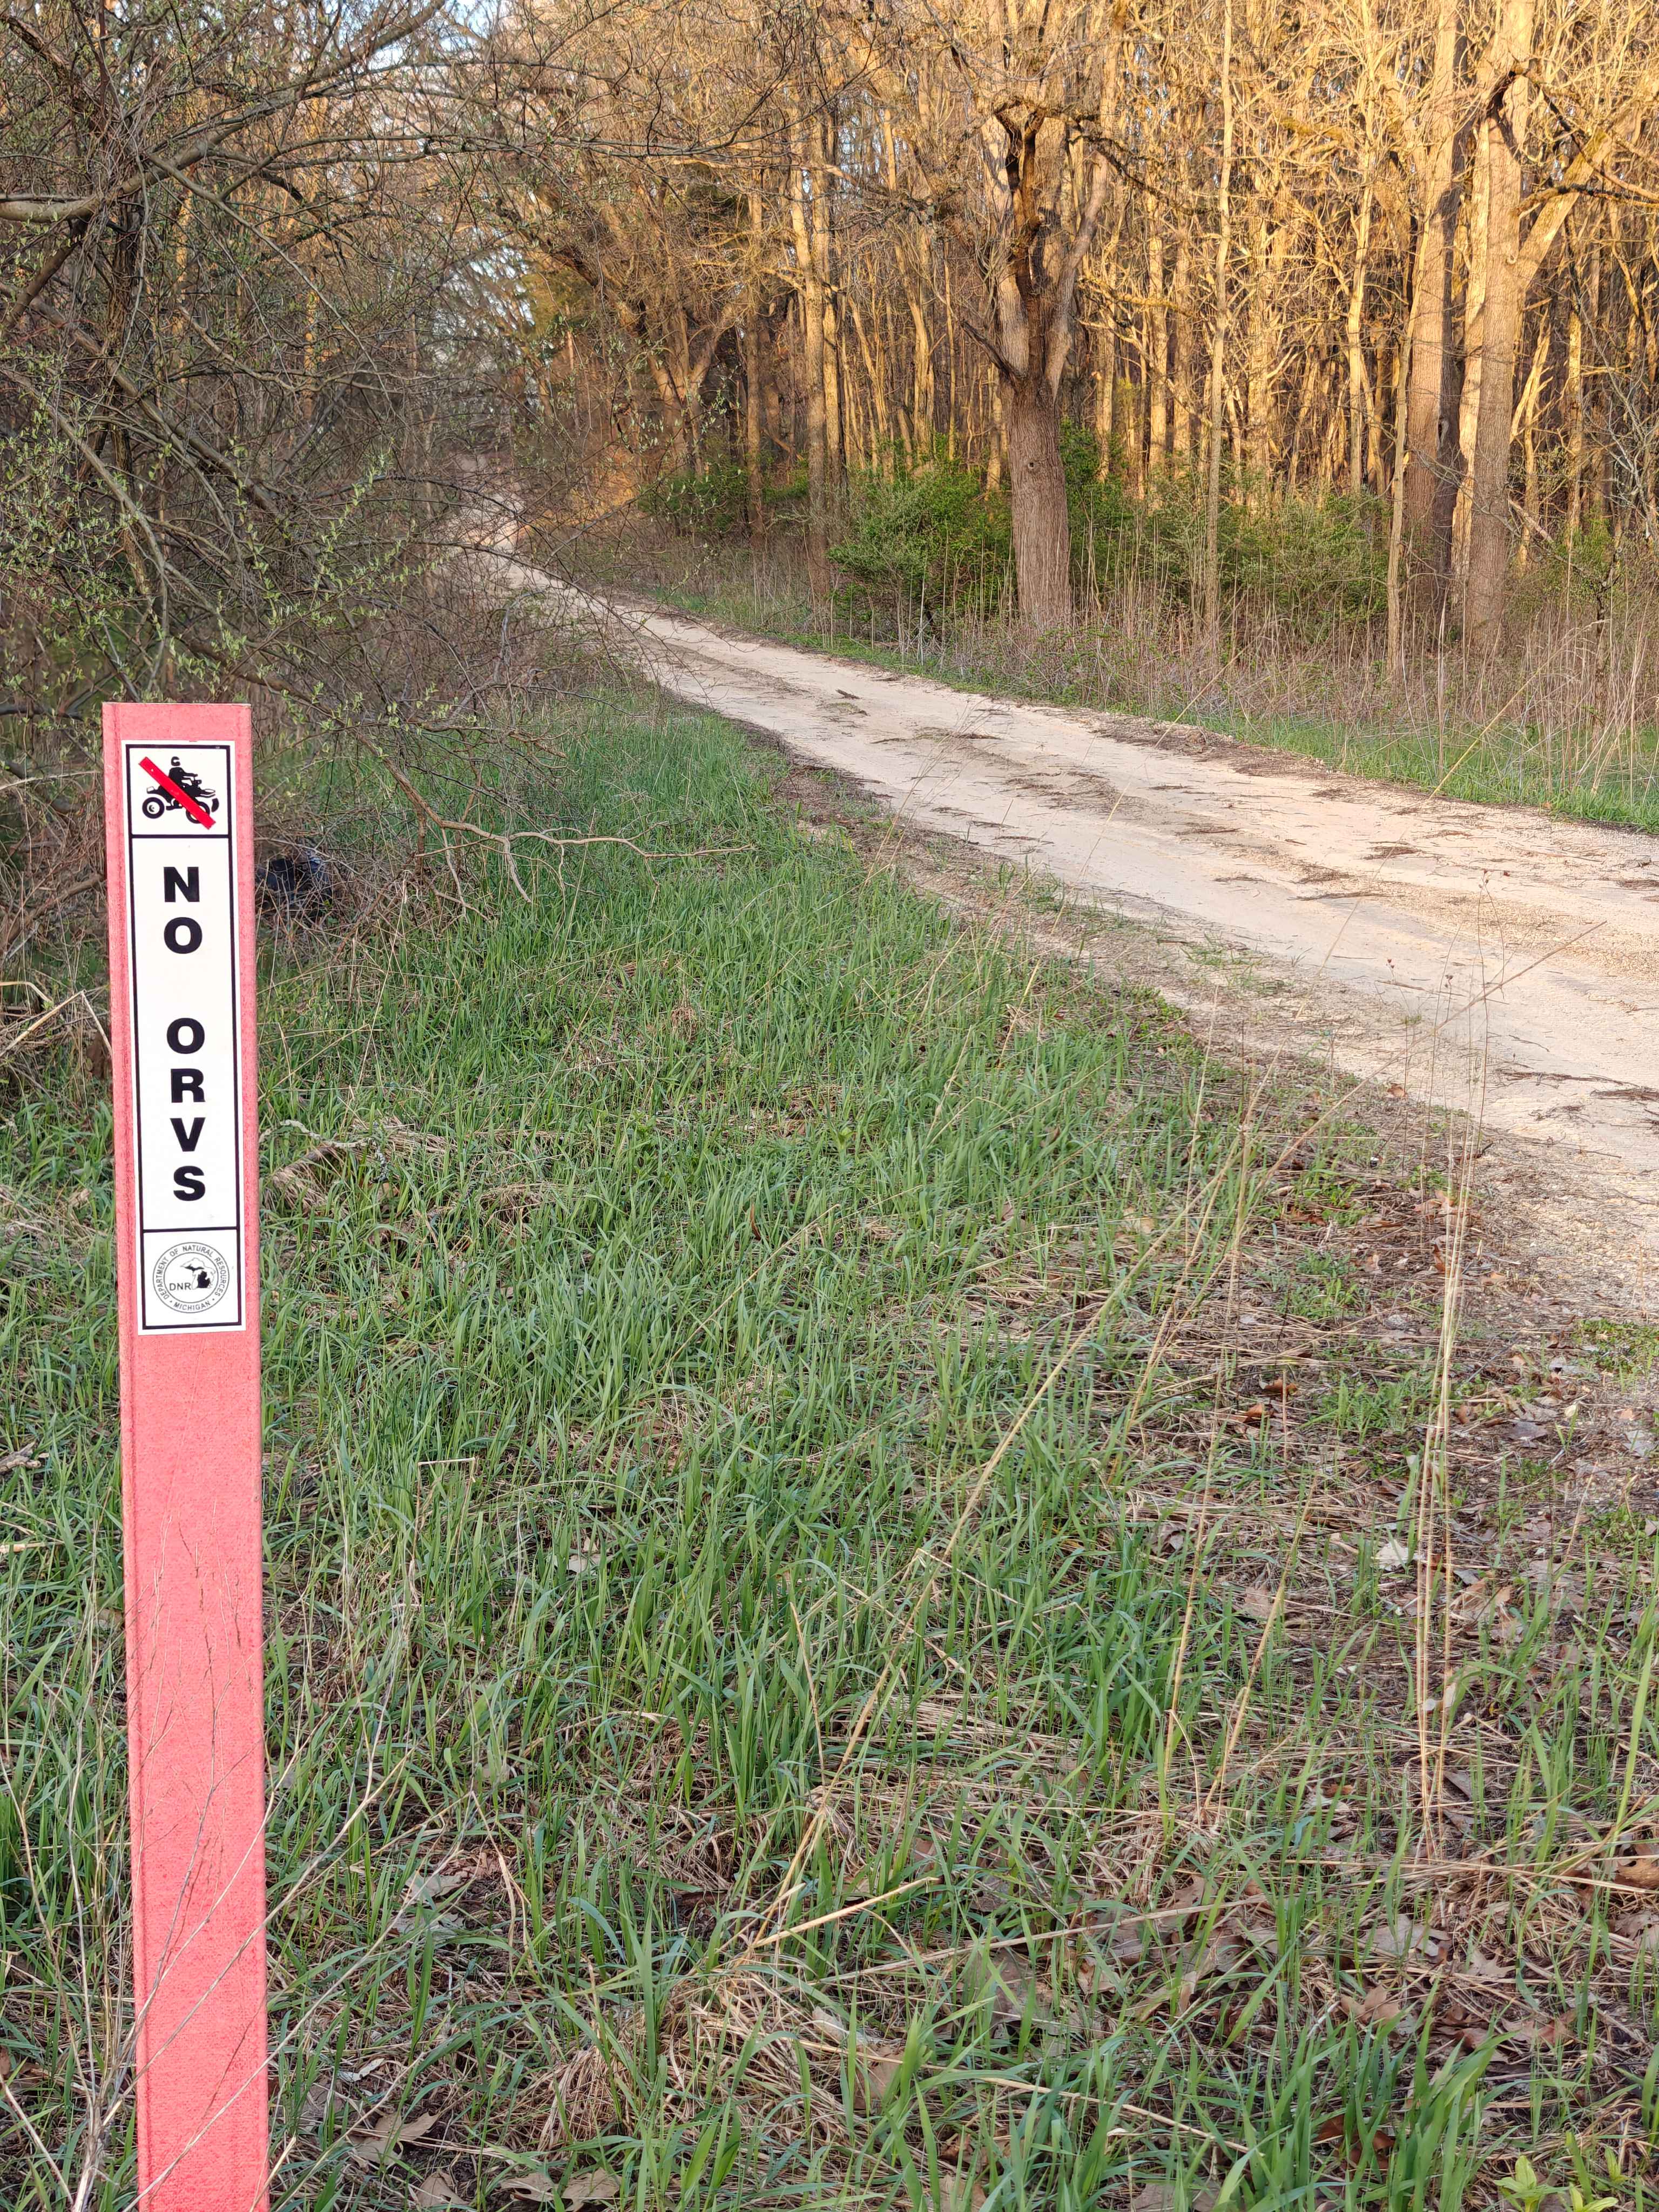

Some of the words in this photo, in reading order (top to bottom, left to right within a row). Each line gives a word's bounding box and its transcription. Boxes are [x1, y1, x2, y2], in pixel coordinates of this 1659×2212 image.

[164, 866, 203, 954] NO
[166, 1017, 206, 1202] ORVS
[156, 1257, 170, 1300] DEPARTMENT
[170, 1249, 179, 1257] OF
[183, 1245, 214, 1257] NATURAL
[214, 1257, 227, 1297] RESOURCES
[169, 1283, 191, 1291] DNR
[173, 1300, 211, 1311] MICHIGAN
